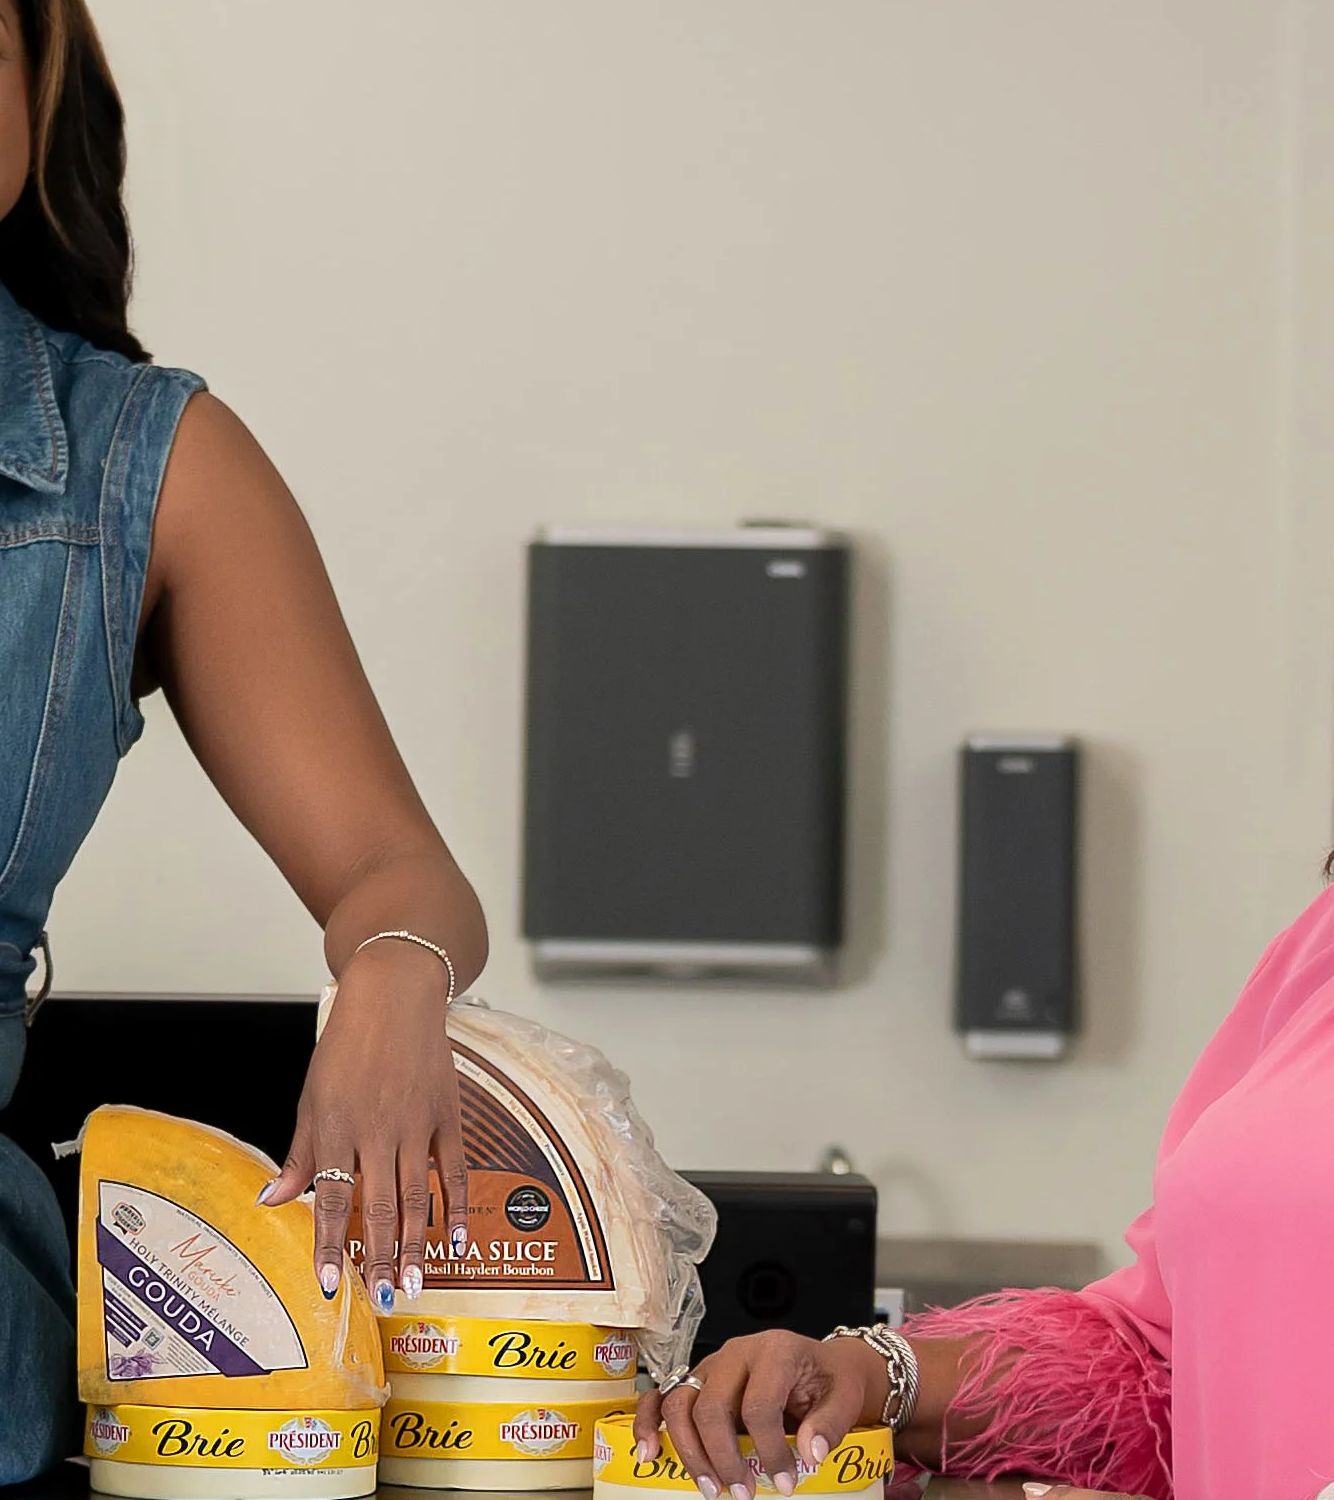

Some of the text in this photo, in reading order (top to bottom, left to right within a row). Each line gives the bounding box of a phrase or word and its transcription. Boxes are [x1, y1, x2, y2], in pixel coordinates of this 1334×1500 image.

[424, 1262, 555, 1279] Basil Hayden Bourbon
[465, 1240, 483, 1260] A
[489, 1240, 558, 1261] SLICE
[129, 1237, 158, 1266] HOLY
[158, 1262, 203, 1302] TRINITY
[198, 1300, 250, 1348] MÉLANGE
[187, 1271, 220, 1302] GOUDA
[127, 1265, 218, 1352] GOUDA
[390, 1334, 458, 1357] PRÉSIDENT
[488, 1331, 578, 1371] Brie
[151, 1419, 245, 1459] Brie
[267, 1428, 342, 1455] PRÉSIDENT
[391, 1411, 579, 1451] Brie PRÉSIDENT
[832, 1445, 893, 1484] Brie
